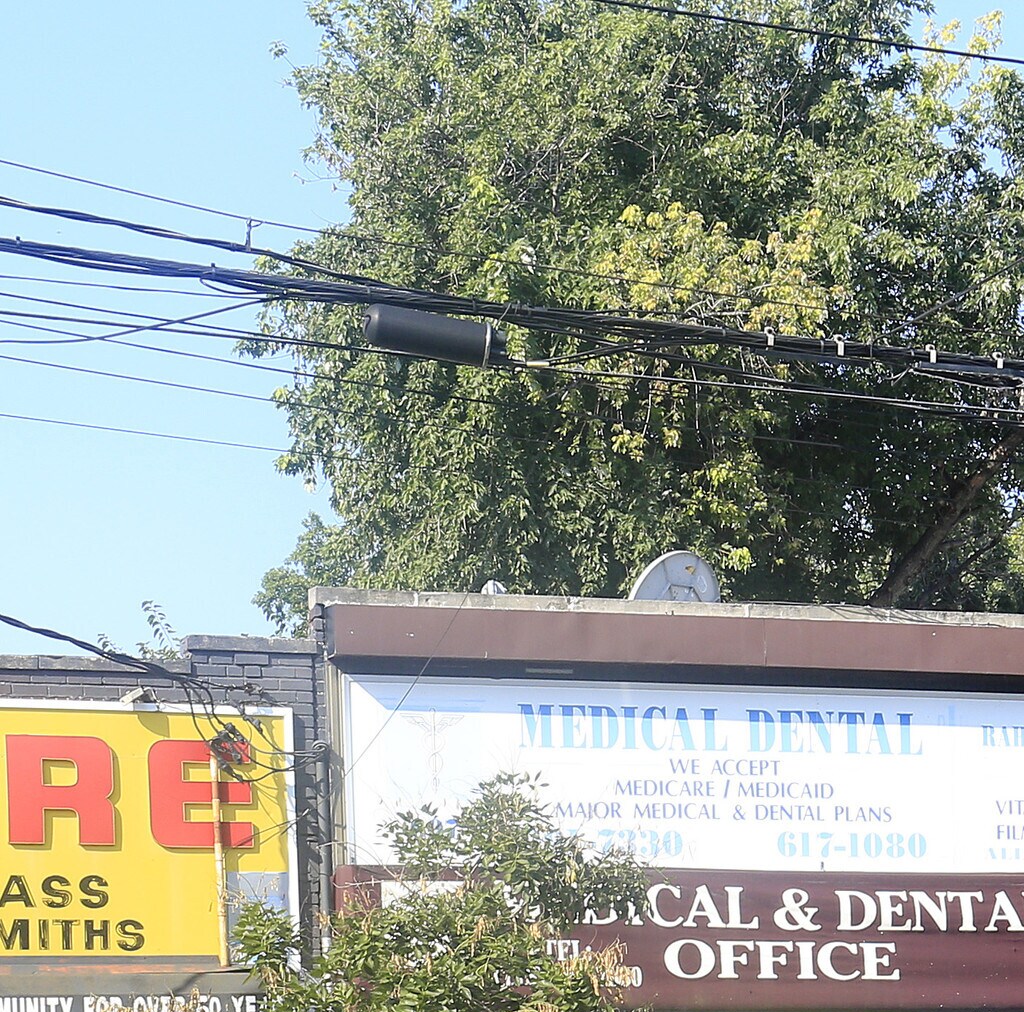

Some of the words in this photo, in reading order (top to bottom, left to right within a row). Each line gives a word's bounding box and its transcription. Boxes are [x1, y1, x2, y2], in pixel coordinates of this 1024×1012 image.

[518, 703, 728, 751] MEDICAL
[746, 709, 923, 756] DENTAL
[669, 758, 699, 775] WE
[711, 758, 781, 777] ACCEPT
[614, 779, 715, 797] MEDICARE
[737, 781, 834, 799] MEDICAID
[633, 802, 720, 820] MEDICAL
[732, 803, 746, 821] &
[755, 804, 825, 822] DENTAL
[835, 806, 893, 823] PLANS
[777, 831, 927, 858] 617-1080
[0, 875, 110, 909] ASS
[773, 887, 822, 932] &
[663, 938, 901, 982] OFFICE
